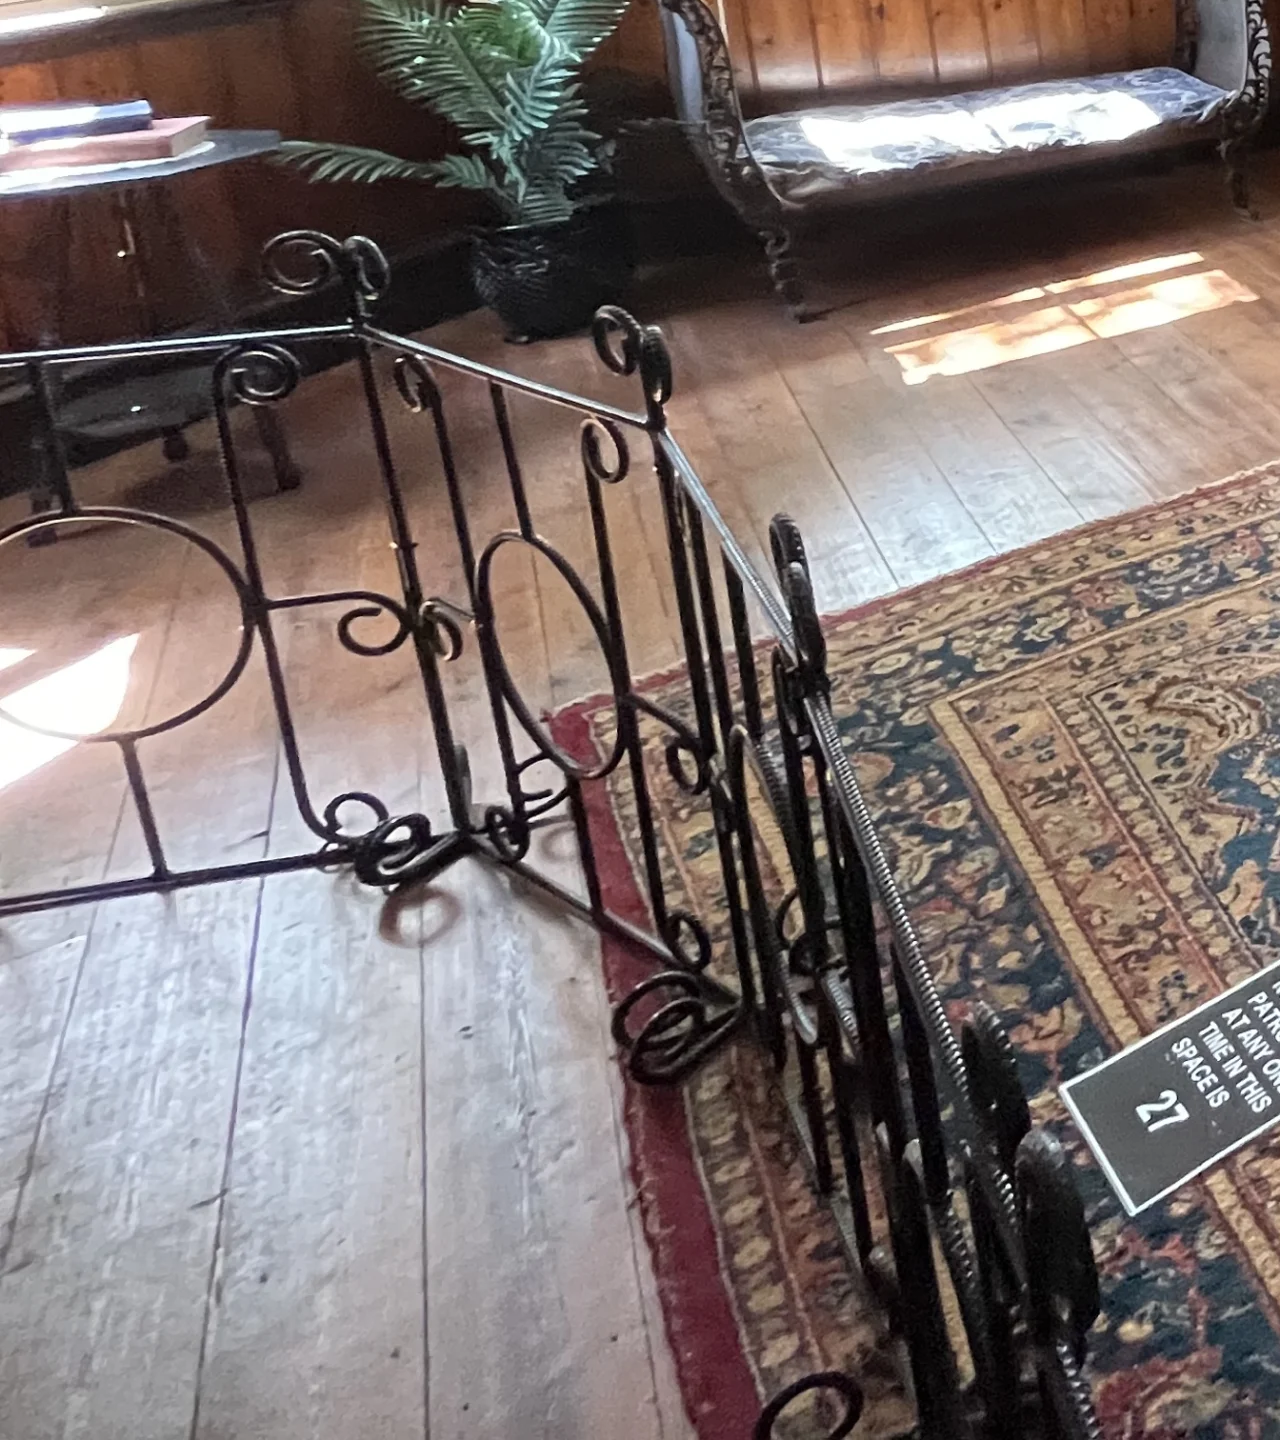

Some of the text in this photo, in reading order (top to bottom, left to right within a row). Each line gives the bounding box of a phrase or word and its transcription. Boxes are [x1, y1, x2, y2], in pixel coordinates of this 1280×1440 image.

[1222, 1008, 1251, 1030] AT
[1237, 1028, 1272, 1063] ANY
[1172, 1037, 1231, 1108] SPACE IS
[1198, 1021, 1273, 1114] TIME IN THIS
[1136, 1089, 1190, 1133] 27
